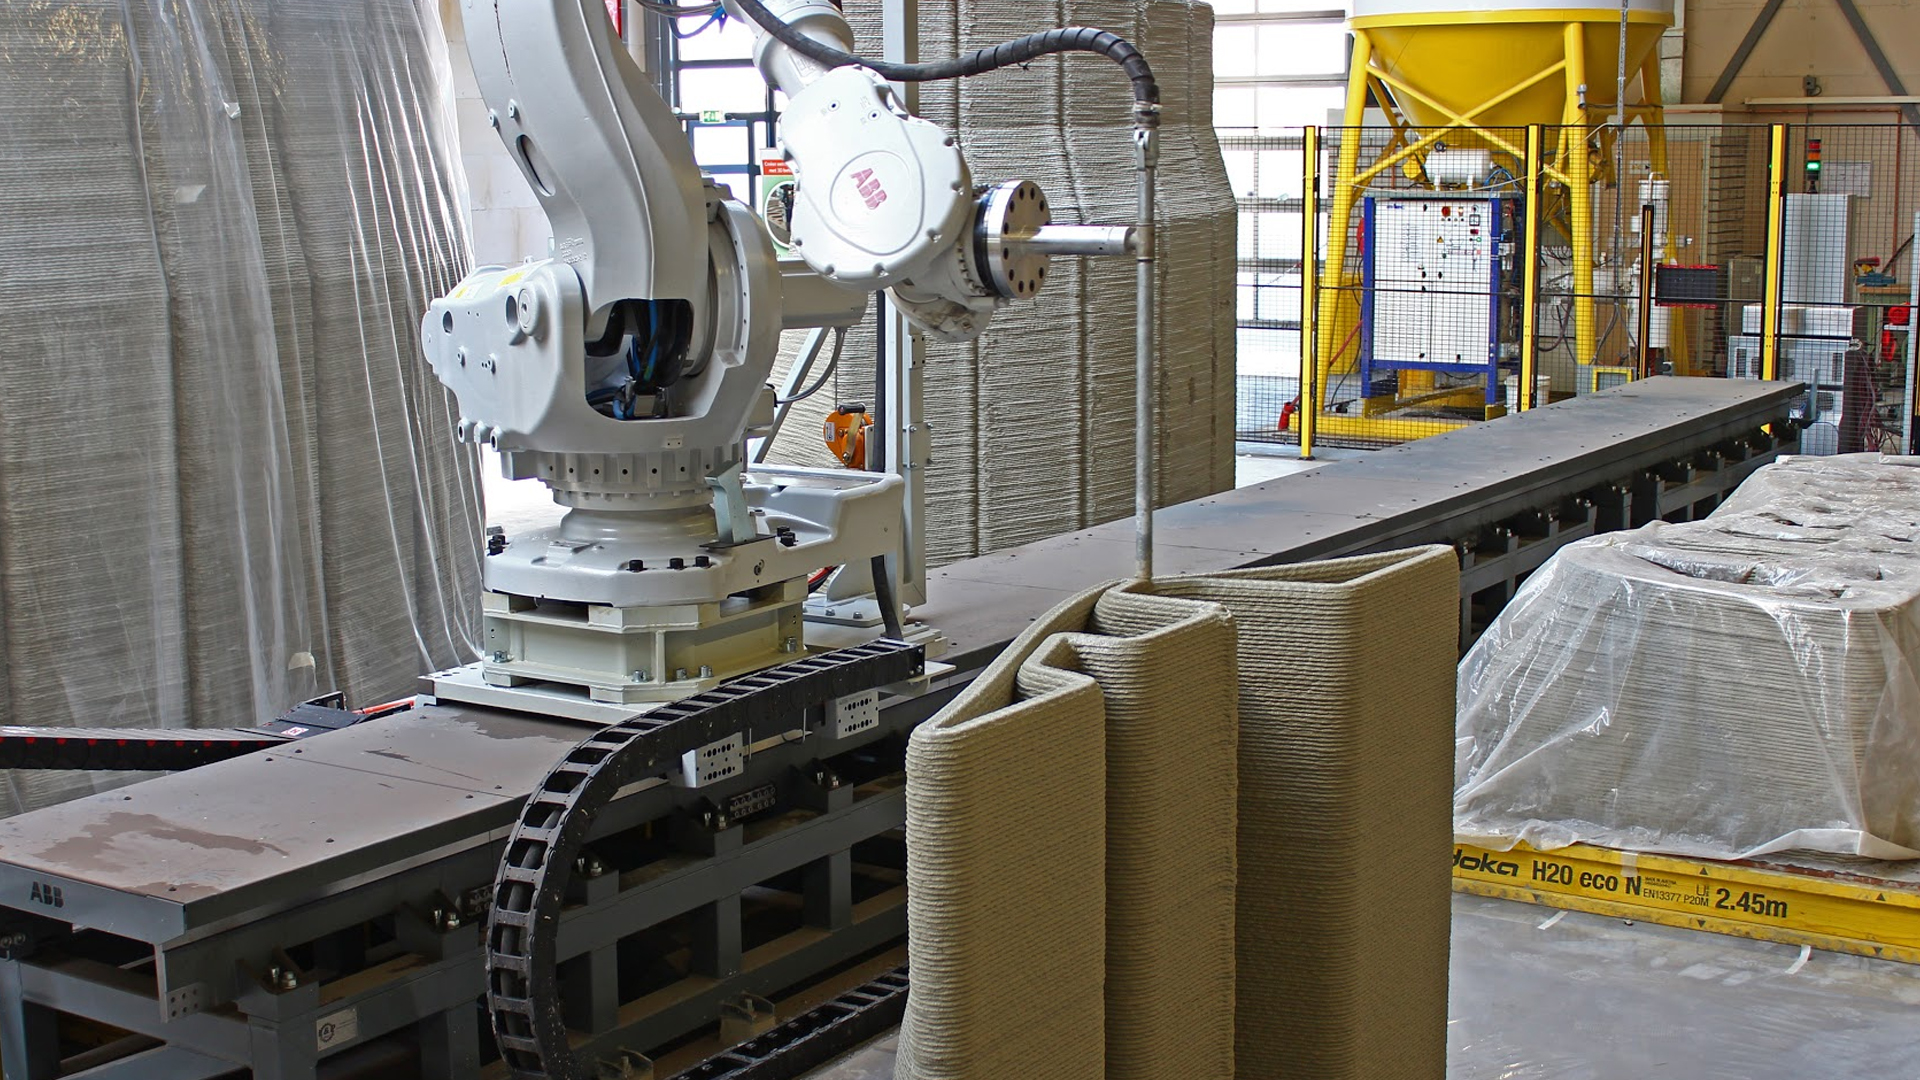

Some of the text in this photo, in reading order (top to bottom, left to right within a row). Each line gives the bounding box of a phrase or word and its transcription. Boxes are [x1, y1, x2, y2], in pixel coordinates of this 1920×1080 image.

[850, 167, 887, 210] ABB
[1532, 860, 1573, 885] H20
[1580, 872, 1618, 892] eco
[1625, 875, 1641, 896] N
[30, 881, 64, 908] ABB
[1643, 888, 1709, 907] EN13377 P20M
[1716, 888, 1787, 918] 2.45m
